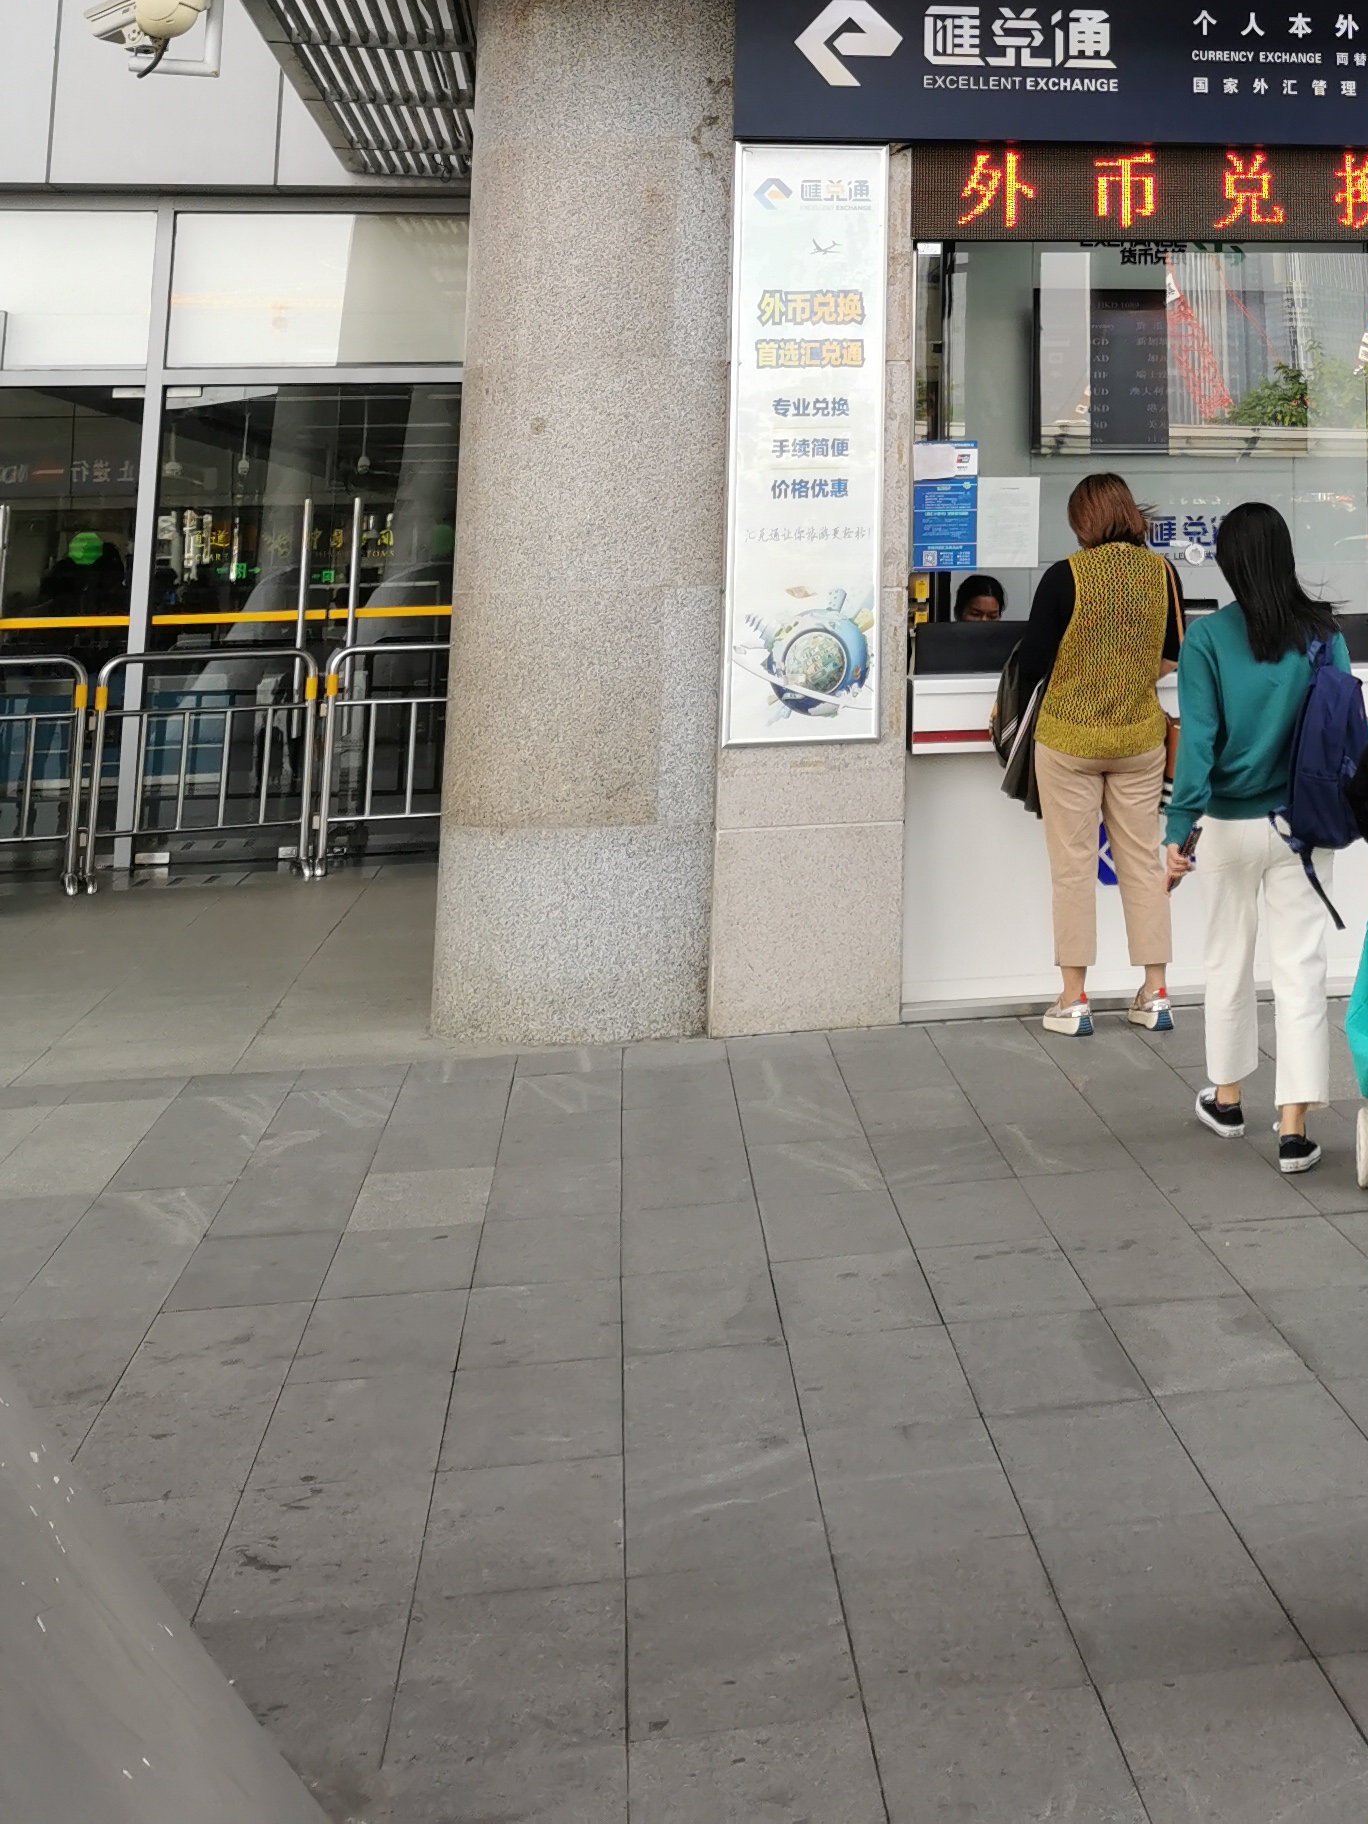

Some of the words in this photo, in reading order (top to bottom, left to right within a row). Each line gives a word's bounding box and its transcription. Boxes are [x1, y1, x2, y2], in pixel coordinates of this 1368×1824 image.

[1191, 49, 1255, 63] CURRENCY
[1259, 51, 1322, 64] EXCHANGE
[922, 75, 1023, 90] EXCELLENT
[1025, 77, 1120, 92] EXCHANGE
[758, 290, 864, 325] 外币兑换
[757, 339, 864, 367] 首选汇兑通
[771, 397, 851, 418] 专业兑换
[771, 437, 850, 459] 手续简便
[770, 478, 849, 500] 价格优惠
